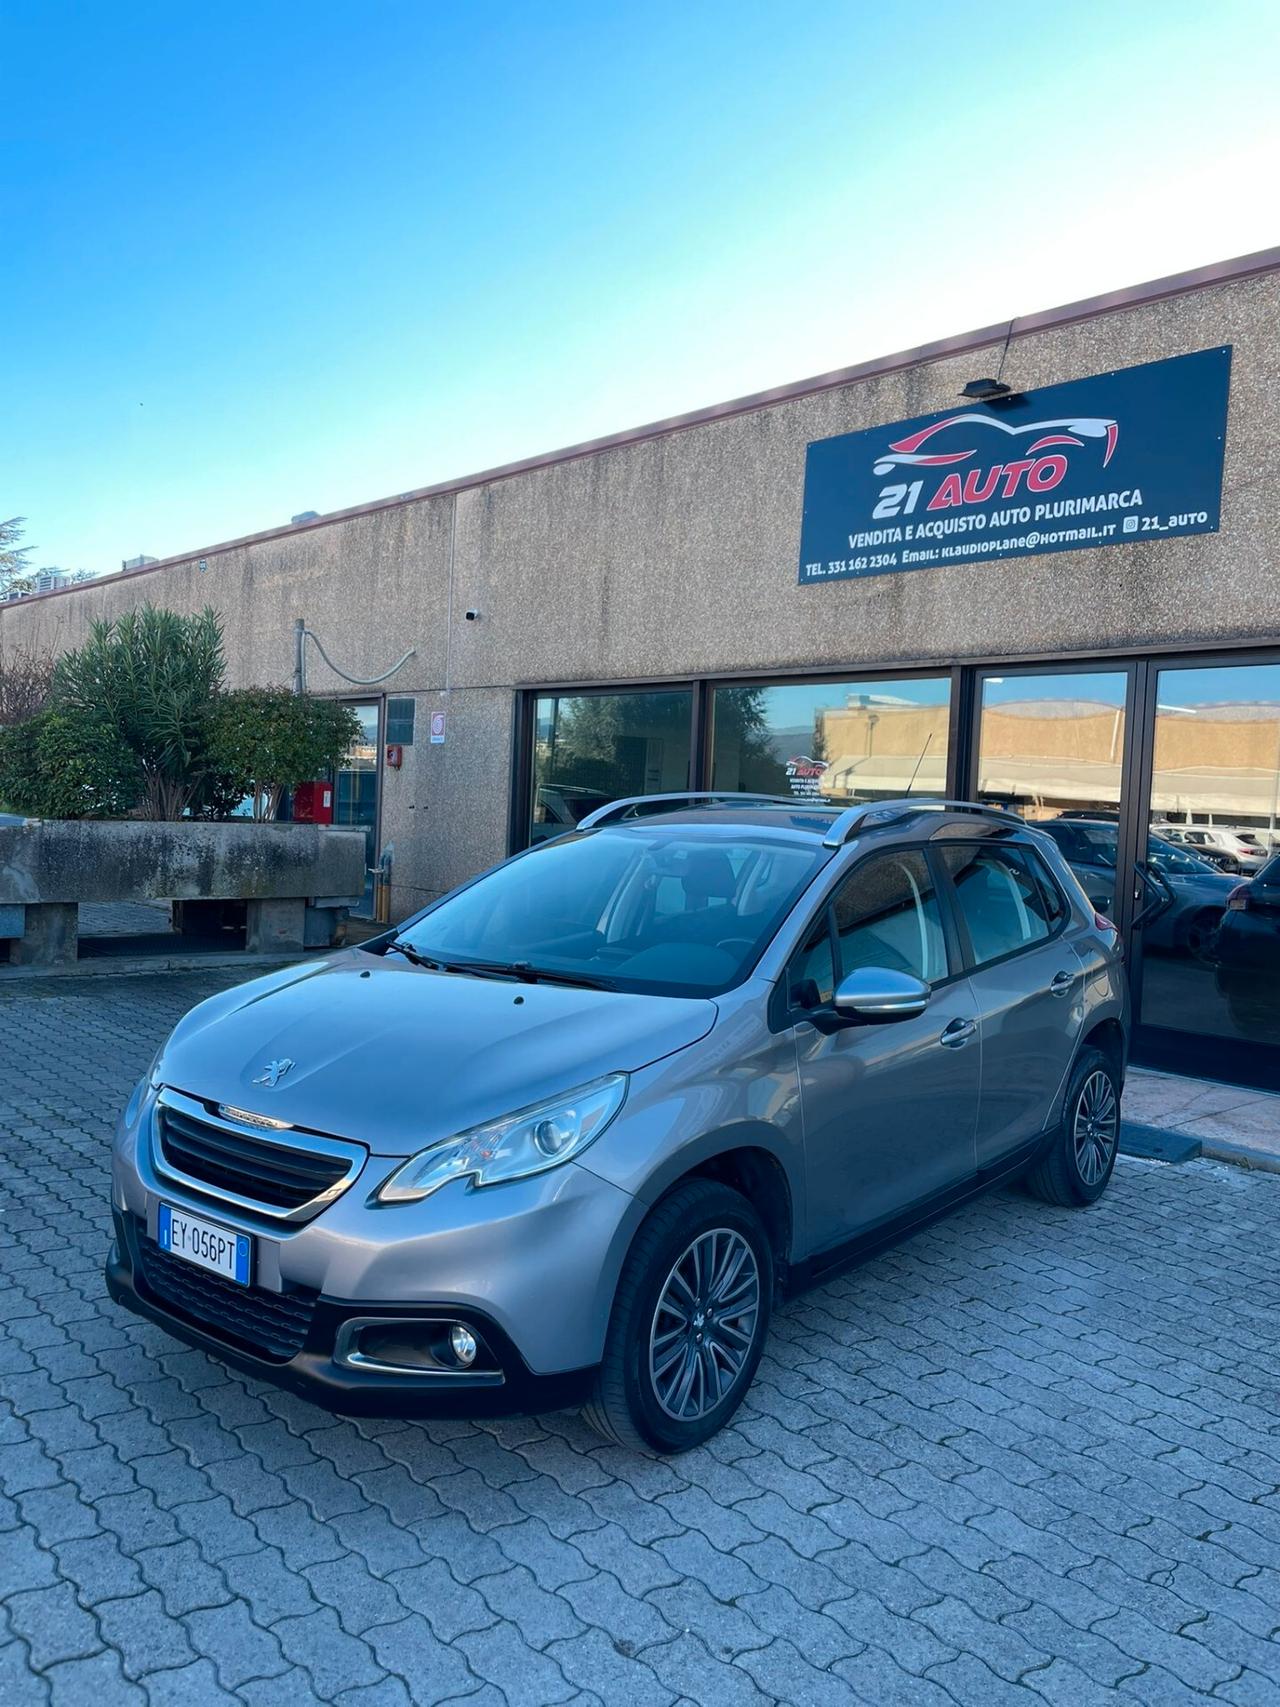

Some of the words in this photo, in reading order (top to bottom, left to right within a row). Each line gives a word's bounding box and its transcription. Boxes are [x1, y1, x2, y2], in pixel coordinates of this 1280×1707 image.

[872, 480, 924, 519] 21
[926, 454, 1068, 511] AUTO
[849, 528, 901, 549] VENDITA
[905, 525, 914, 540] E
[916, 514, 986, 538] ACQUISTO
[989, 507, 1031, 528] AUTO
[1035, 489, 1143, 521] PLURIMARCA
[806, 562, 826, 576] TEL.
[828, 560, 847, 574] 331
[849, 556, 867, 571] 162
[869, 552, 898, 568] 2304
[785, 767, 796, 775] 21
[797, 767, 822, 776] AUTO
[172, 1218, 187, 1249] EY
[192, 1227, 235, 1269] 056PT
